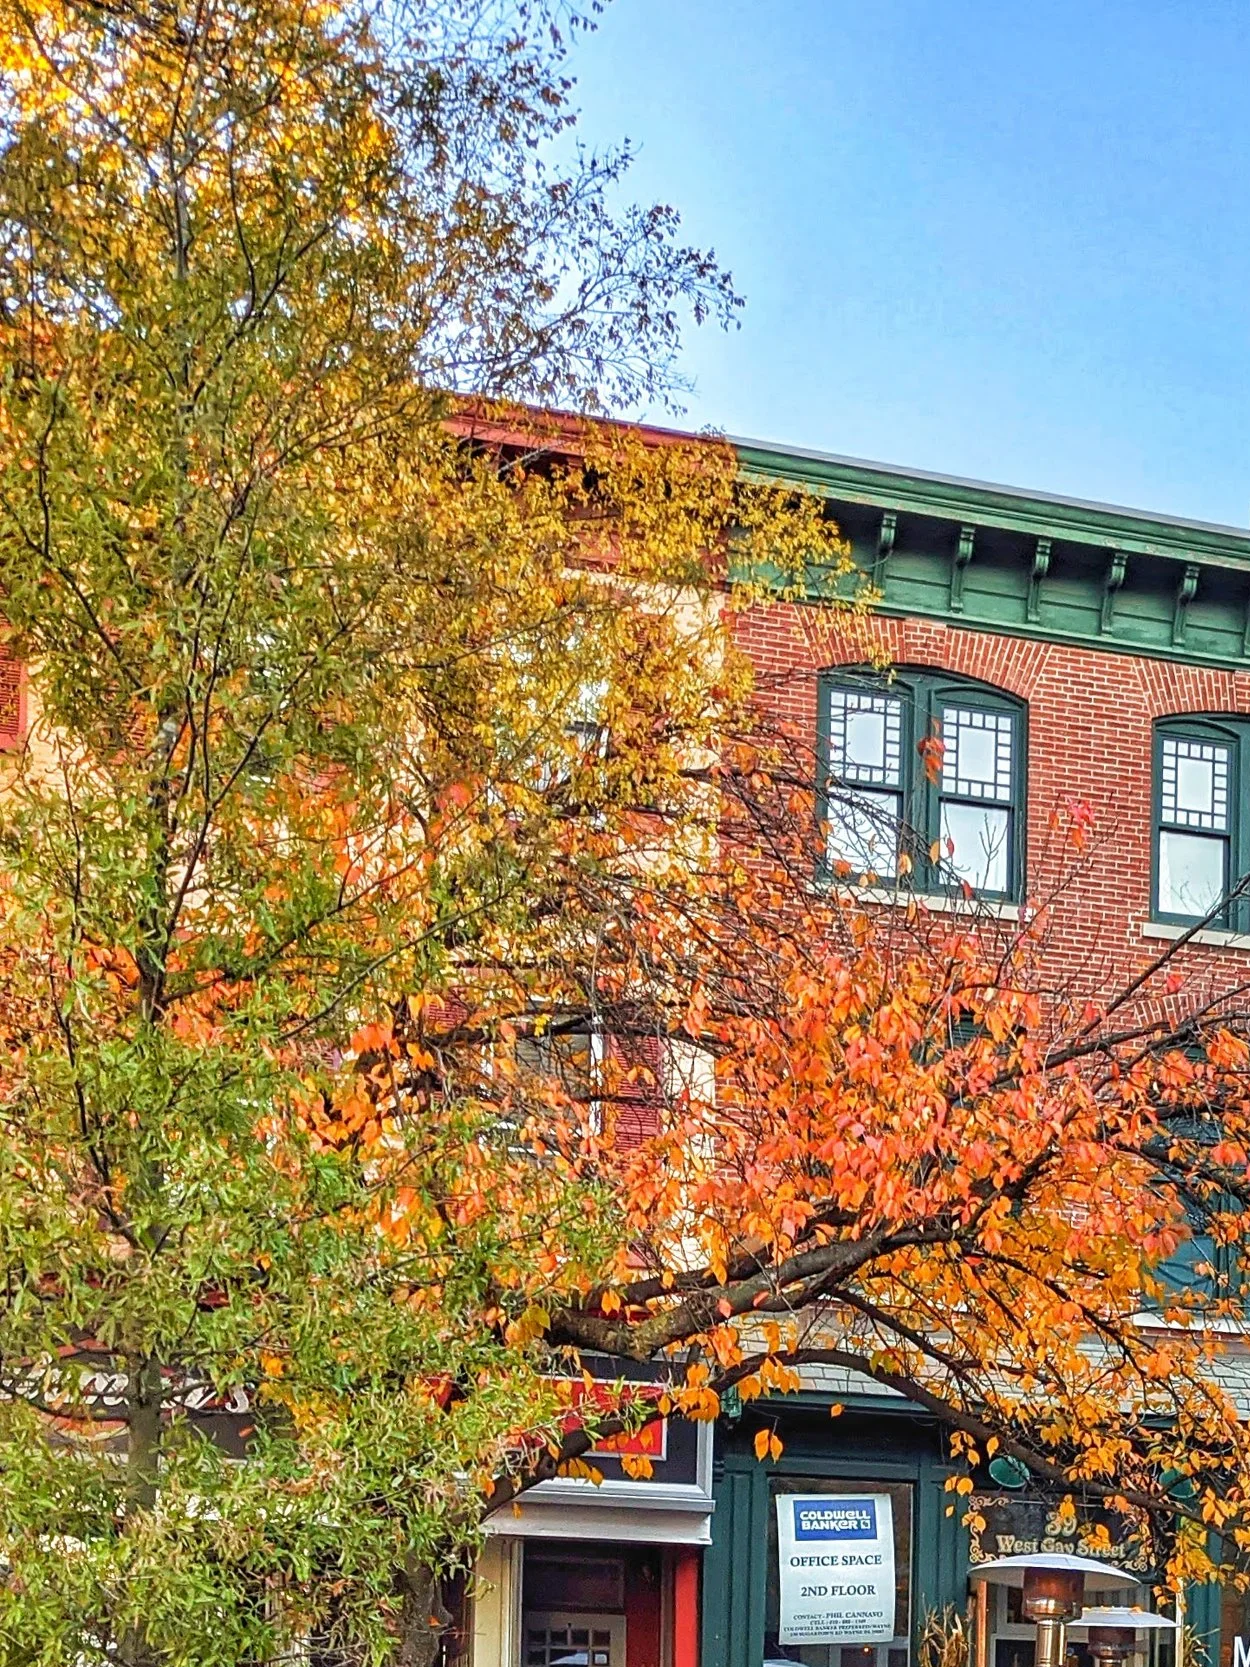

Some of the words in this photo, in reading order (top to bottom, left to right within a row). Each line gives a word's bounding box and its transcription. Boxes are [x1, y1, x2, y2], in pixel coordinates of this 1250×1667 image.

[1045, 1512, 1077, 1536] 39
[995, 1534, 1039, 1553] West
[790, 1556, 839, 1567] OFFICE
[841, 1555, 882, 1566] SPACE
[801, 1586, 828, 1597] 2ND
[831, 1585, 876, 1596] FLOOR
